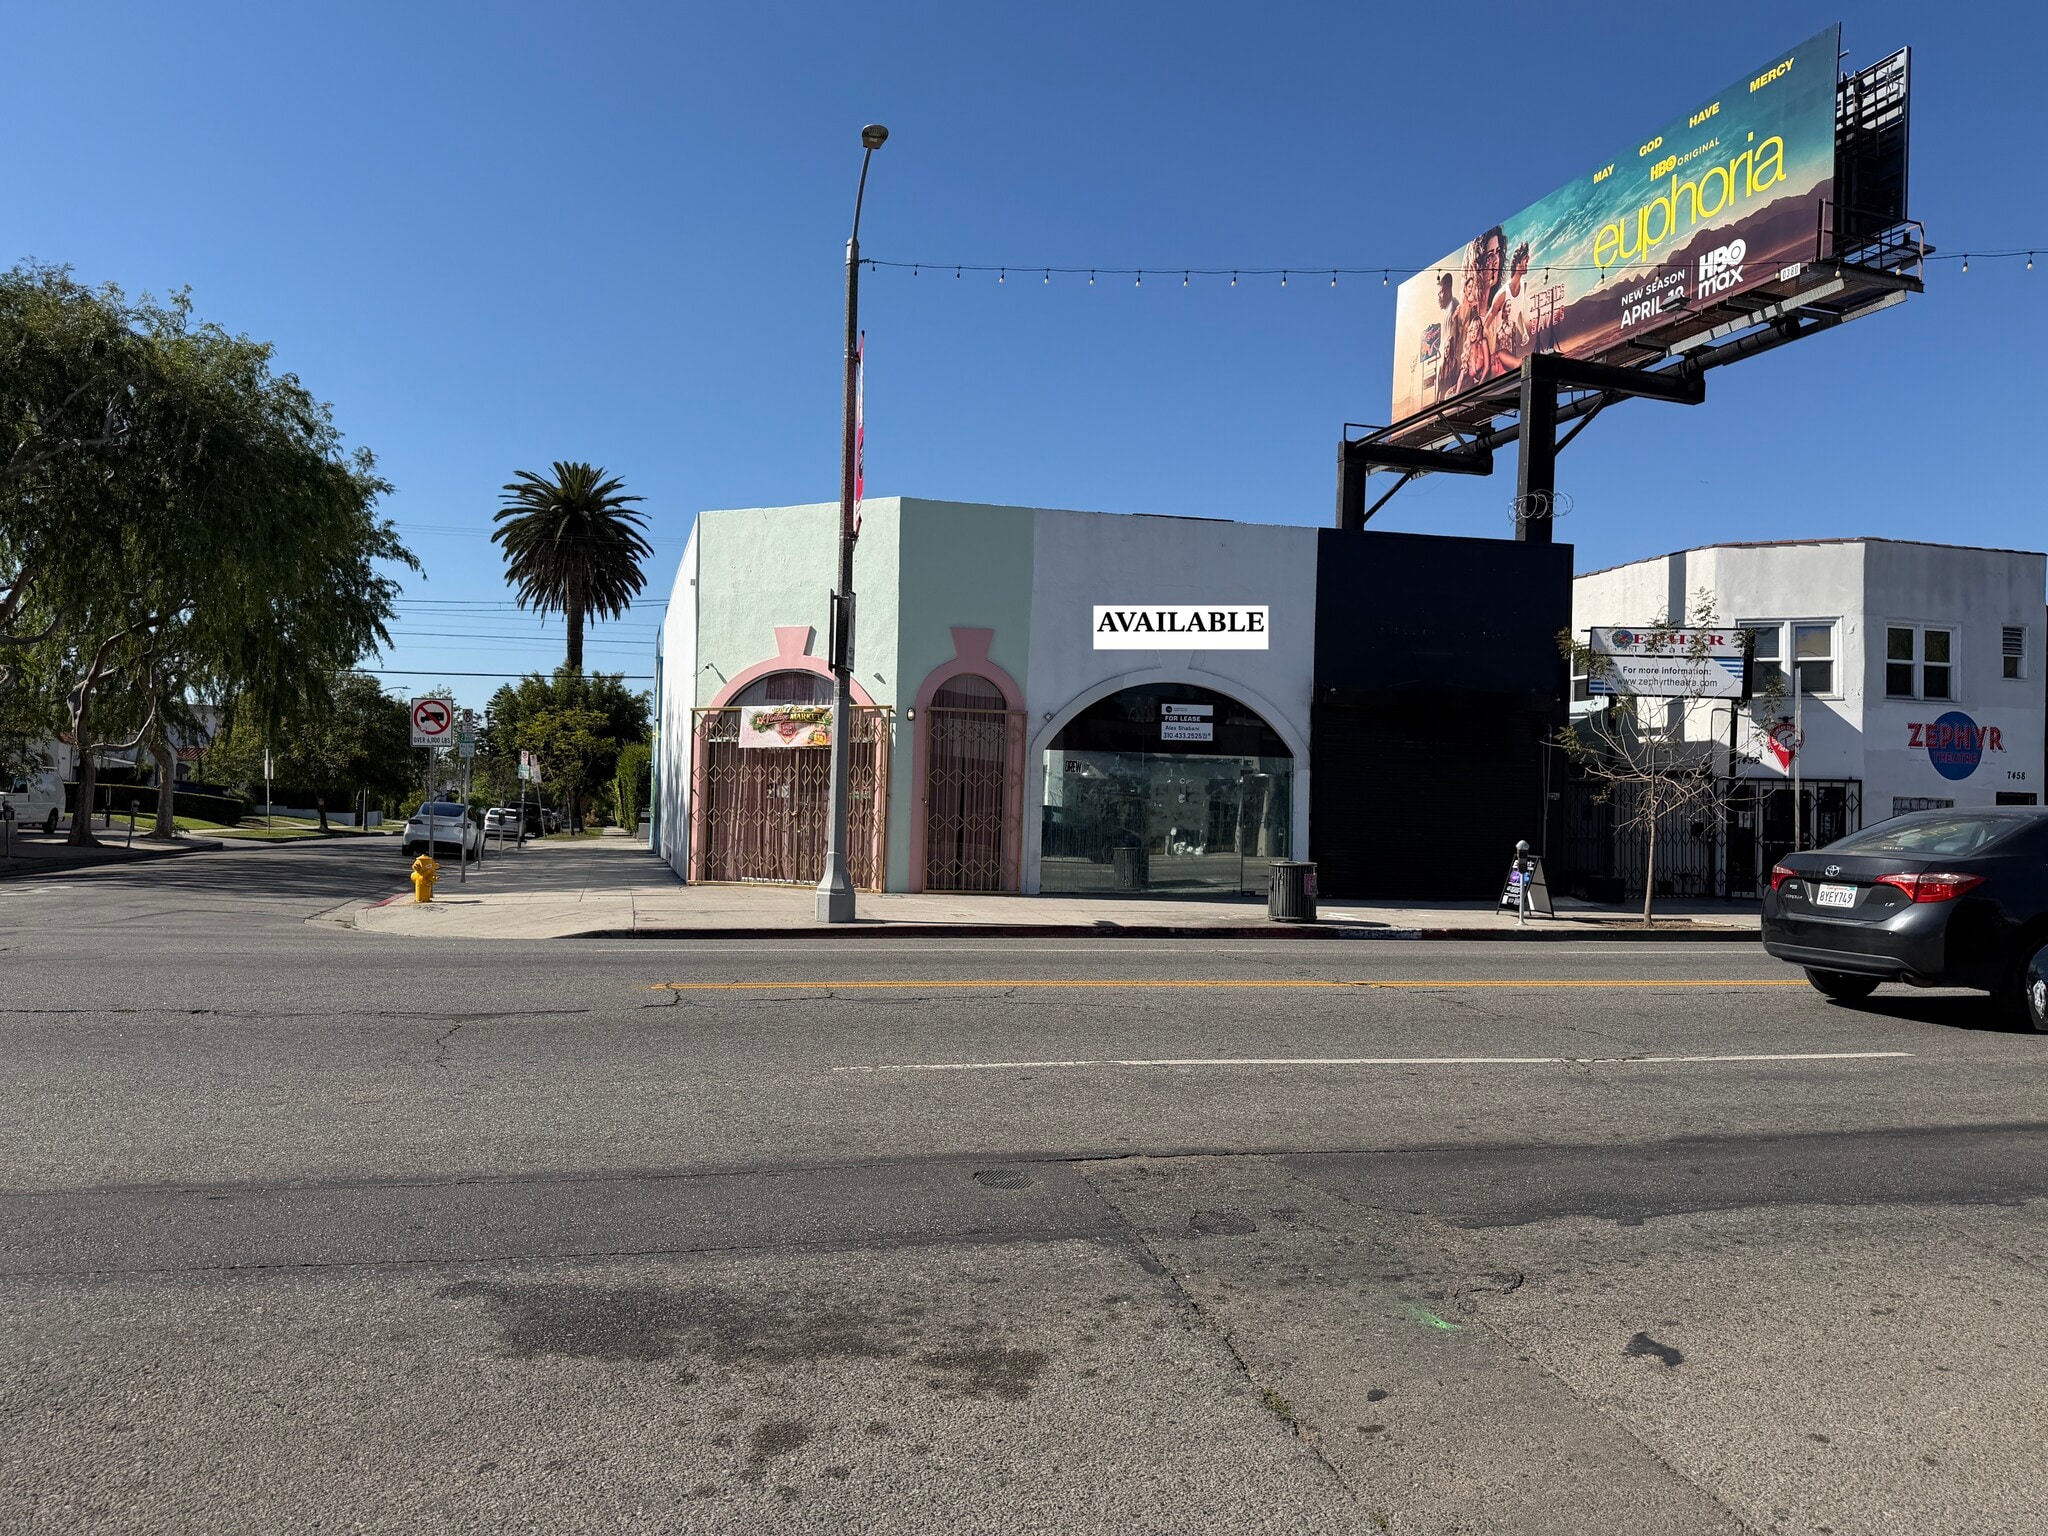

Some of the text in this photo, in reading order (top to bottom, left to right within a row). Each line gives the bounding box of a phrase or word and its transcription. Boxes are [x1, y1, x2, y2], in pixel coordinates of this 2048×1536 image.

[1593, 57, 1795, 184] MAY GOD HAVE MERCY
[1650, 137, 1720, 182] HBO ORIGINAL
[1593, 131, 1787, 268] euphoria
[1699, 238, 1747, 281] HBO
[1621, 287, 1644, 306] NEW
[1645, 269, 1686, 296] SEASON
[1698, 265, 1744, 300] max
[1620, 295, 1664, 329] APRIL
[1622, 666, 1637, 674] For
[1907, 722, 2006, 753] ZEPHYR
[1933, 751, 1978, 765] THEATRE
[2007, 771, 2026, 781] 7458
